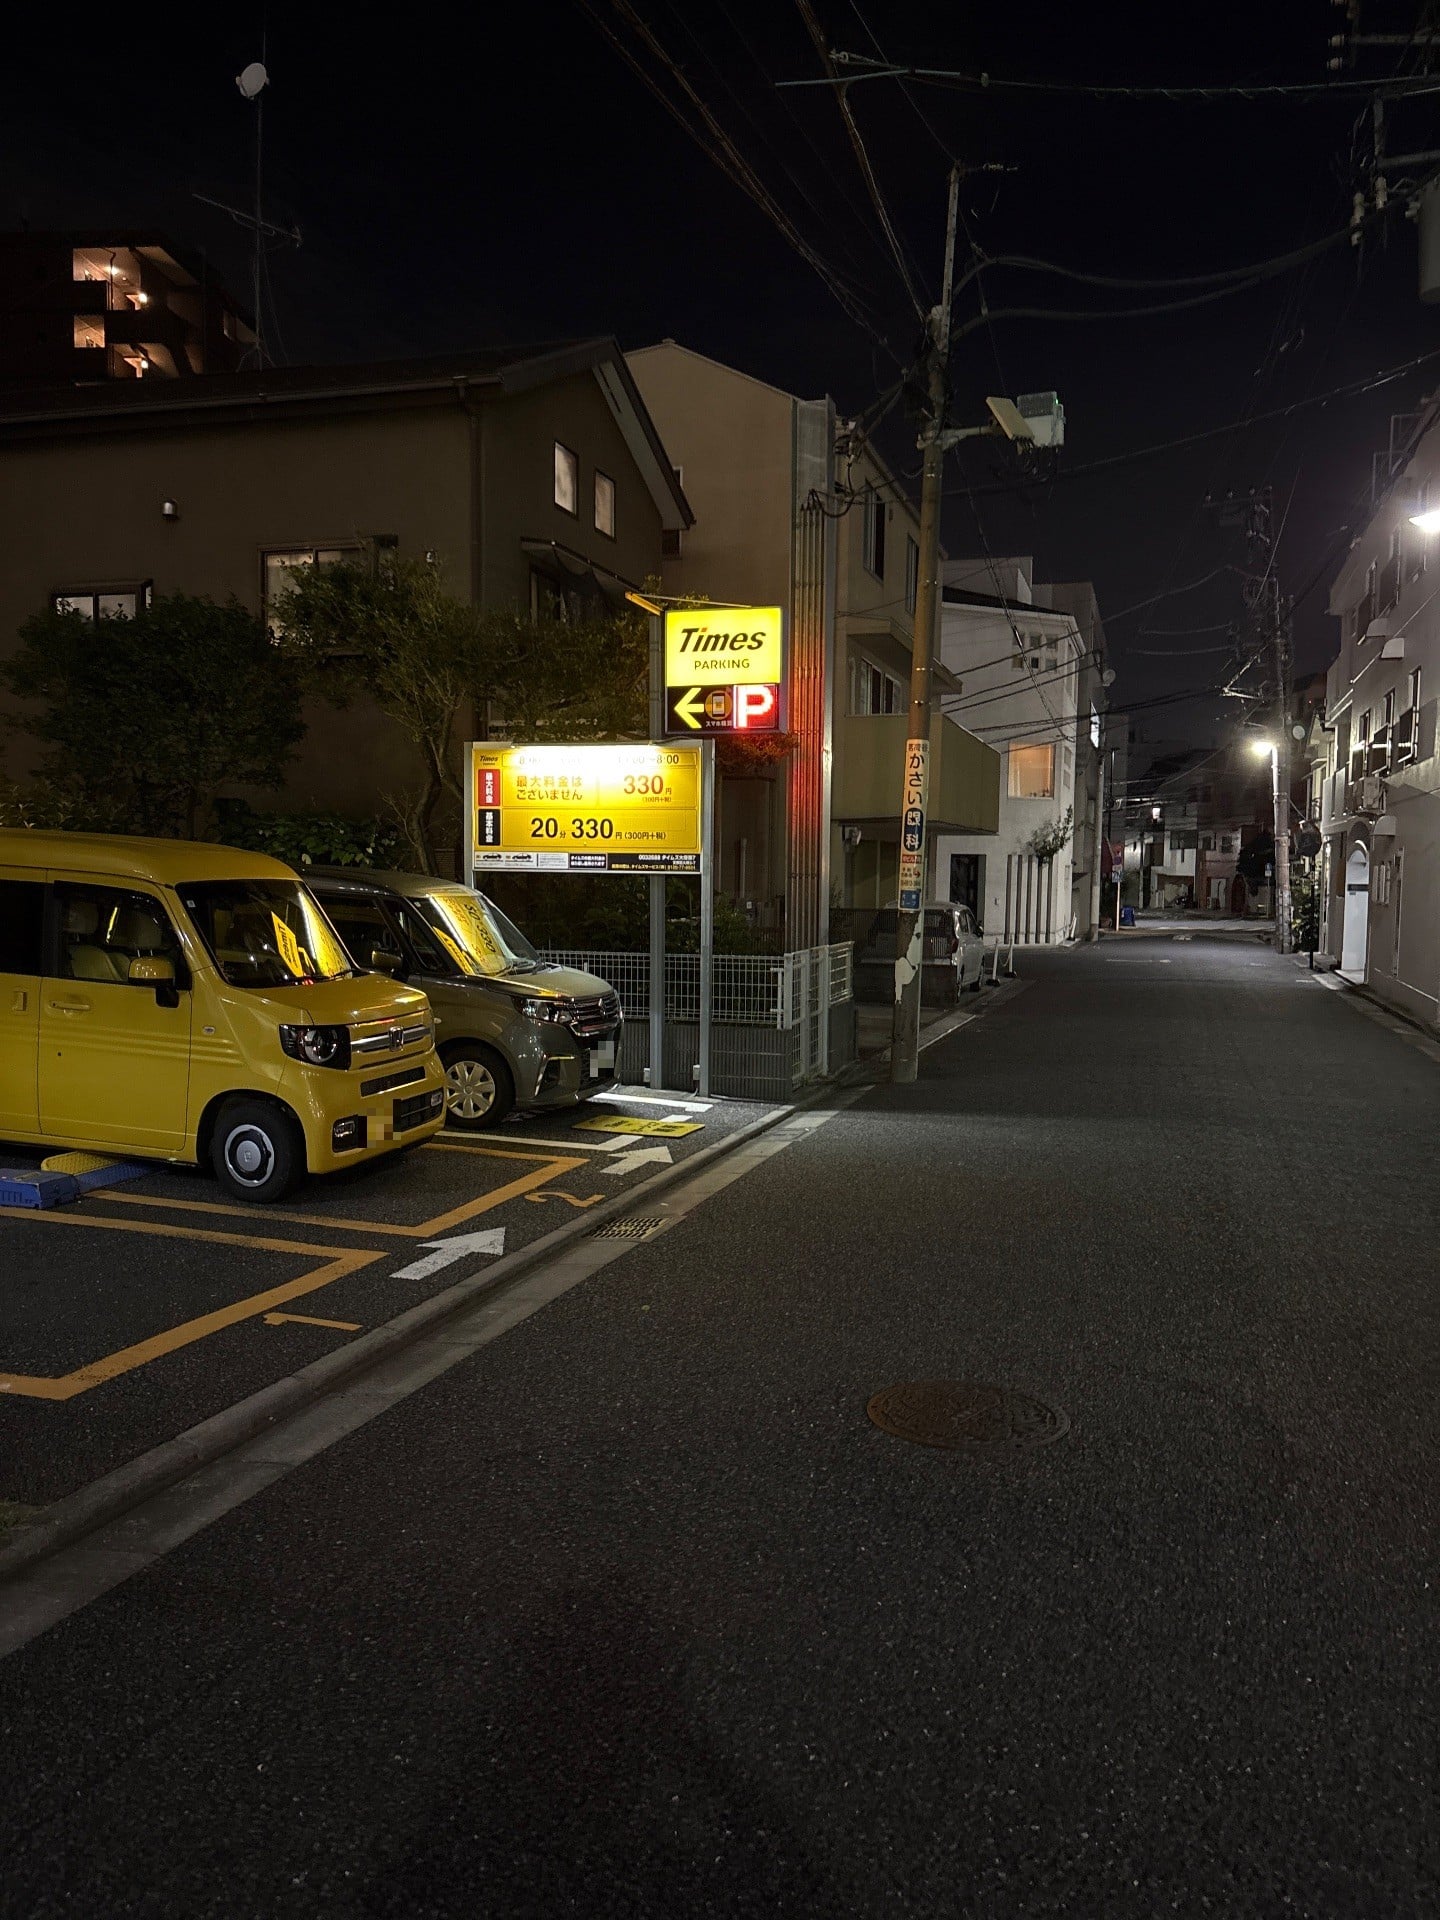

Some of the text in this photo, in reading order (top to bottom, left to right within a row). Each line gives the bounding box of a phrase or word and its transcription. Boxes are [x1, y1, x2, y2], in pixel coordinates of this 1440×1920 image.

[680, 627, 766, 652] Times
[694, 659, 750, 670] PARKING
[737, 685, 774, 728] P
[516, 776, 583, 787] 最大料金は
[516, 789, 583, 801] ございません
[524, 1191, 606, 1208] 2
